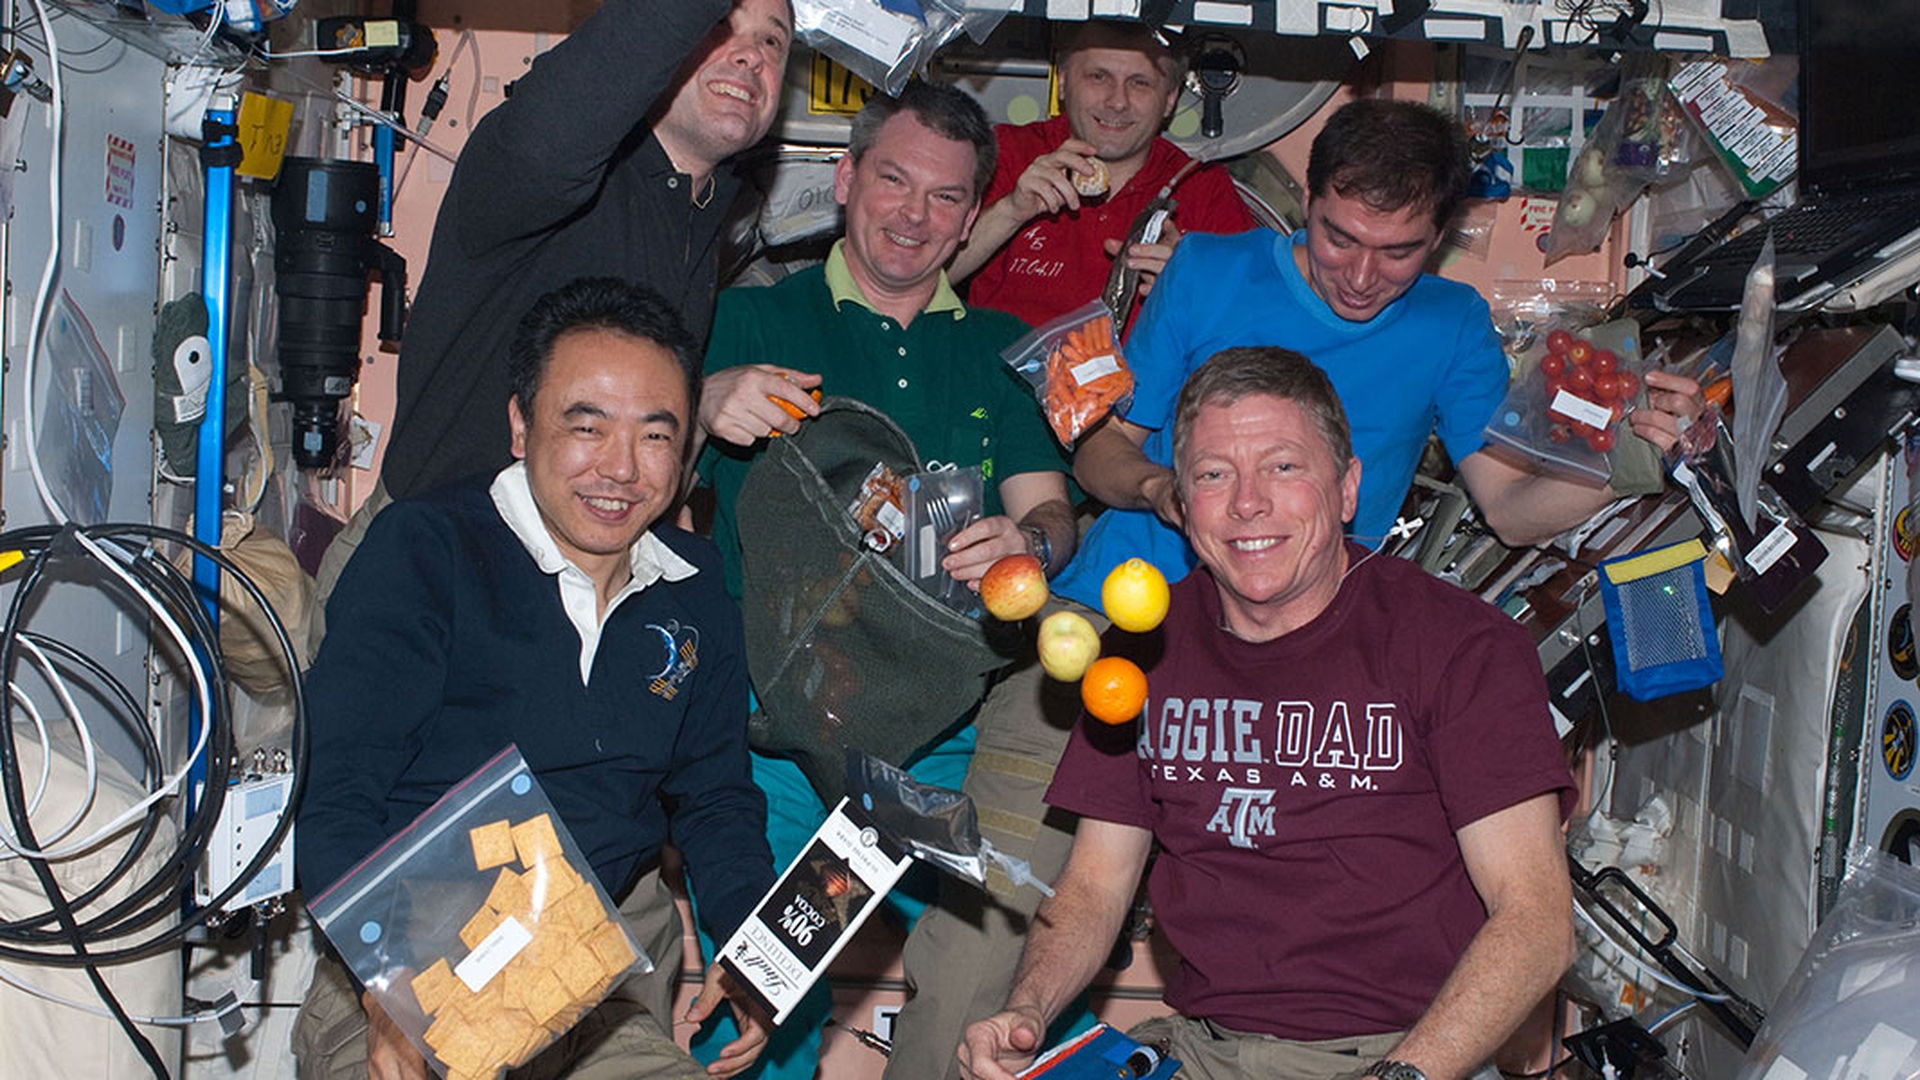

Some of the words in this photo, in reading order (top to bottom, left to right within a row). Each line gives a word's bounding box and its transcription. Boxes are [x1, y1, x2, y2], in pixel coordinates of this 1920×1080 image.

[1009, 257, 1065, 277] 17.04.11
[1274, 700, 1404, 770] DAD
[1290, 771, 1307, 786] A
[1318, 772, 1336, 789] &
[777, 903, 814, 947] 90%
[793, 894, 827, 929] COCOA
[750, 927, 803, 981] EXCELLENCE
[745, 955, 789, 996] Lindt
